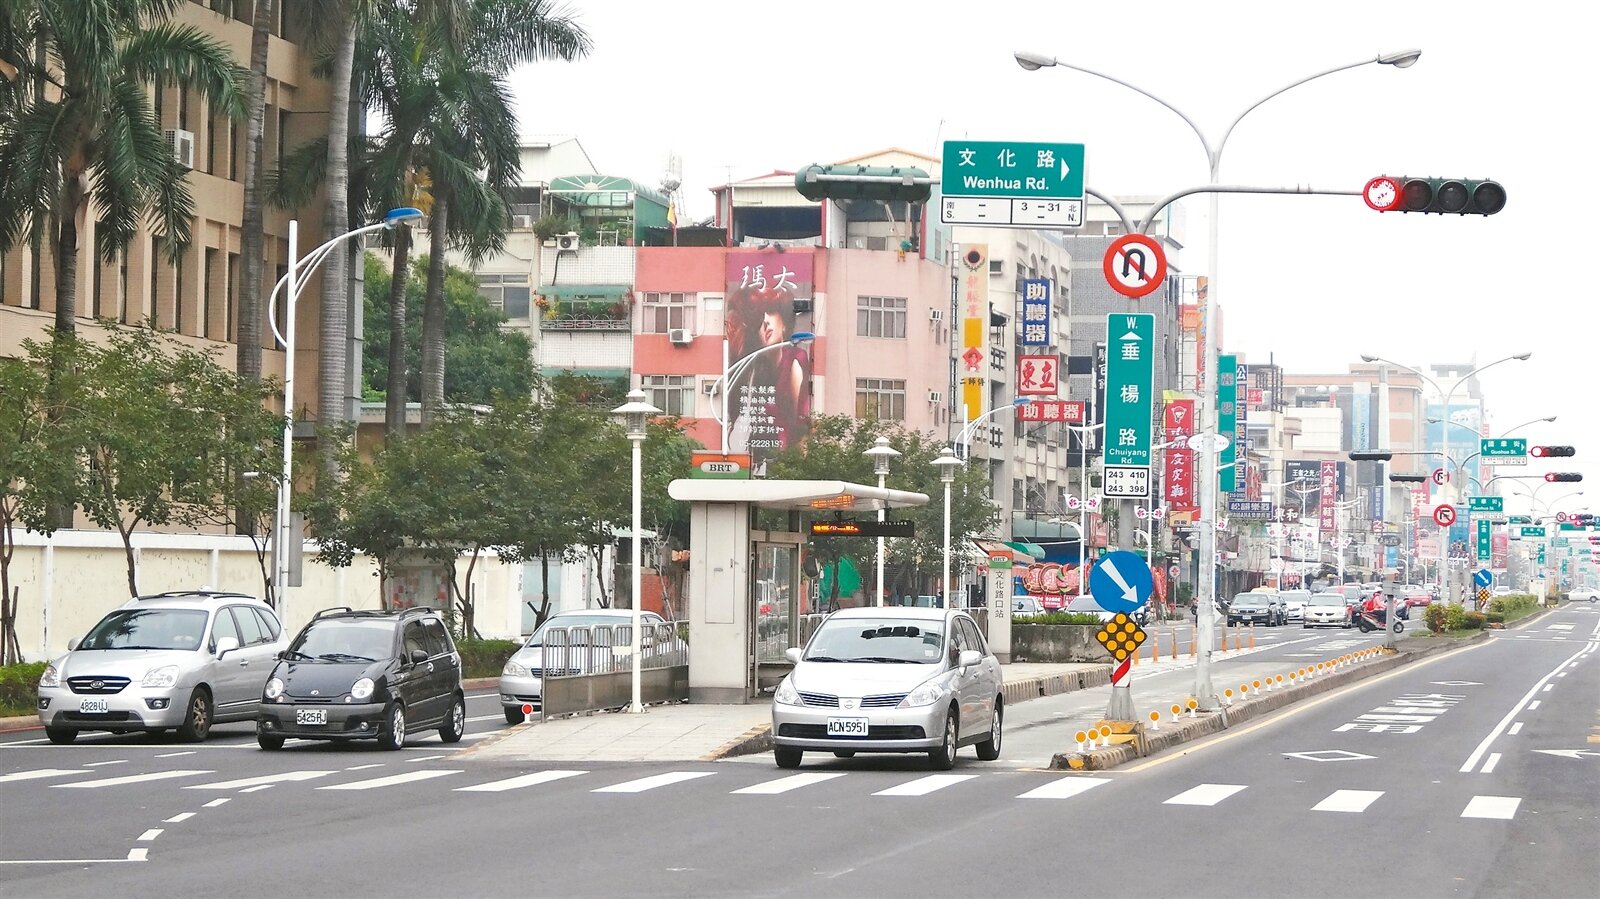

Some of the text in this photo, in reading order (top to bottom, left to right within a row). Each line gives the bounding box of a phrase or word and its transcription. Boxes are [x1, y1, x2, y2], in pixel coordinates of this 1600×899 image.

[958, 147, 1056, 168] 文化路
[963, 175, 1049, 190] Wenhua Rd.
[946, 201, 955, 210] 南
[1021, 202, 1028, 212] 3
[1068, 204, 1077, 213] 北
[946, 211, 955, 219] S.
[1067, 213, 1077, 222] N.
[1026, 283, 1047, 342] 助聽器
[1126, 316, 1138, 329] W.
[1021, 360, 1055, 389] 東立
[1118, 342, 1140, 447] 垂楊路
[1023, 404, 1079, 420] 助聽器
[1109, 448, 1147, 457] Chuiyang
[709, 464, 732, 473] BRT
[1108, 471, 1145, 479] 243 410
[1108, 485, 1145, 493] 243 398
[995, 570, 1004, 618] 文化路口站
